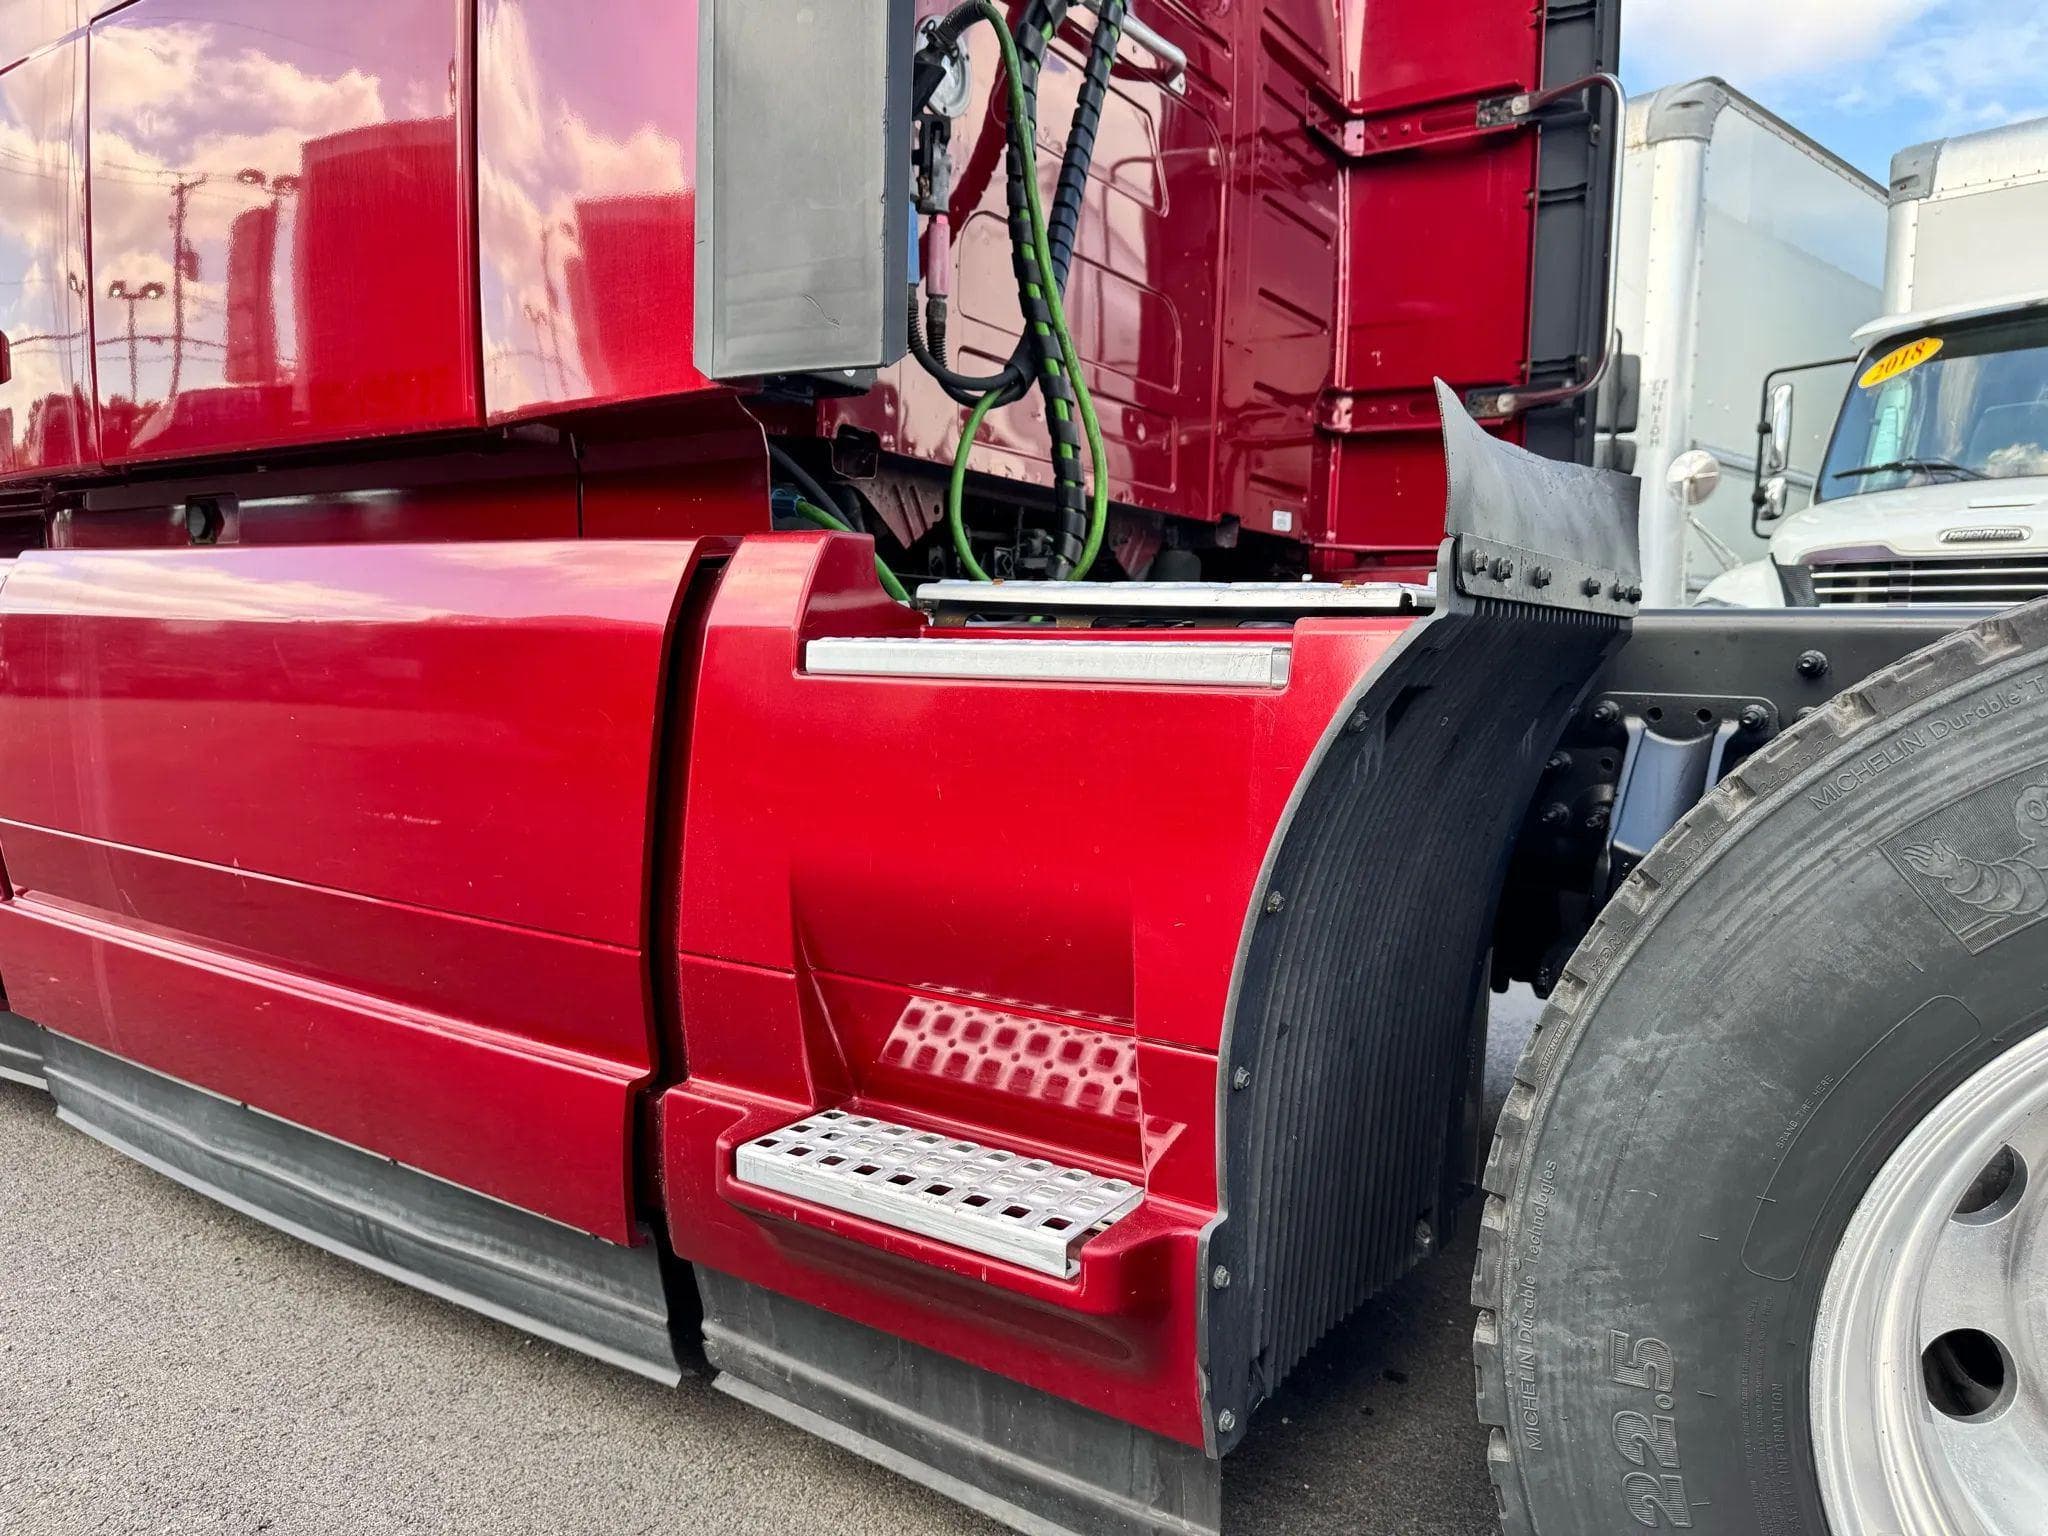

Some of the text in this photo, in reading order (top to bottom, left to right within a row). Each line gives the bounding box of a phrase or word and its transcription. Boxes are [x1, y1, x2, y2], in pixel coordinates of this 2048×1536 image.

[1871, 340, 1926, 381] 2018
[1808, 729, 1928, 811] MICHELIN
[1927, 690, 2021, 740] Durable
[1776, 1074, 1834, 1149] BRAND TIRE HERE
[1518, 1159, 1557, 1451] MICHELIN Durable Technologies
[1609, 1329, 1693, 1528] 22.5
[1771, 1383, 1789, 1474] INFORMATION
